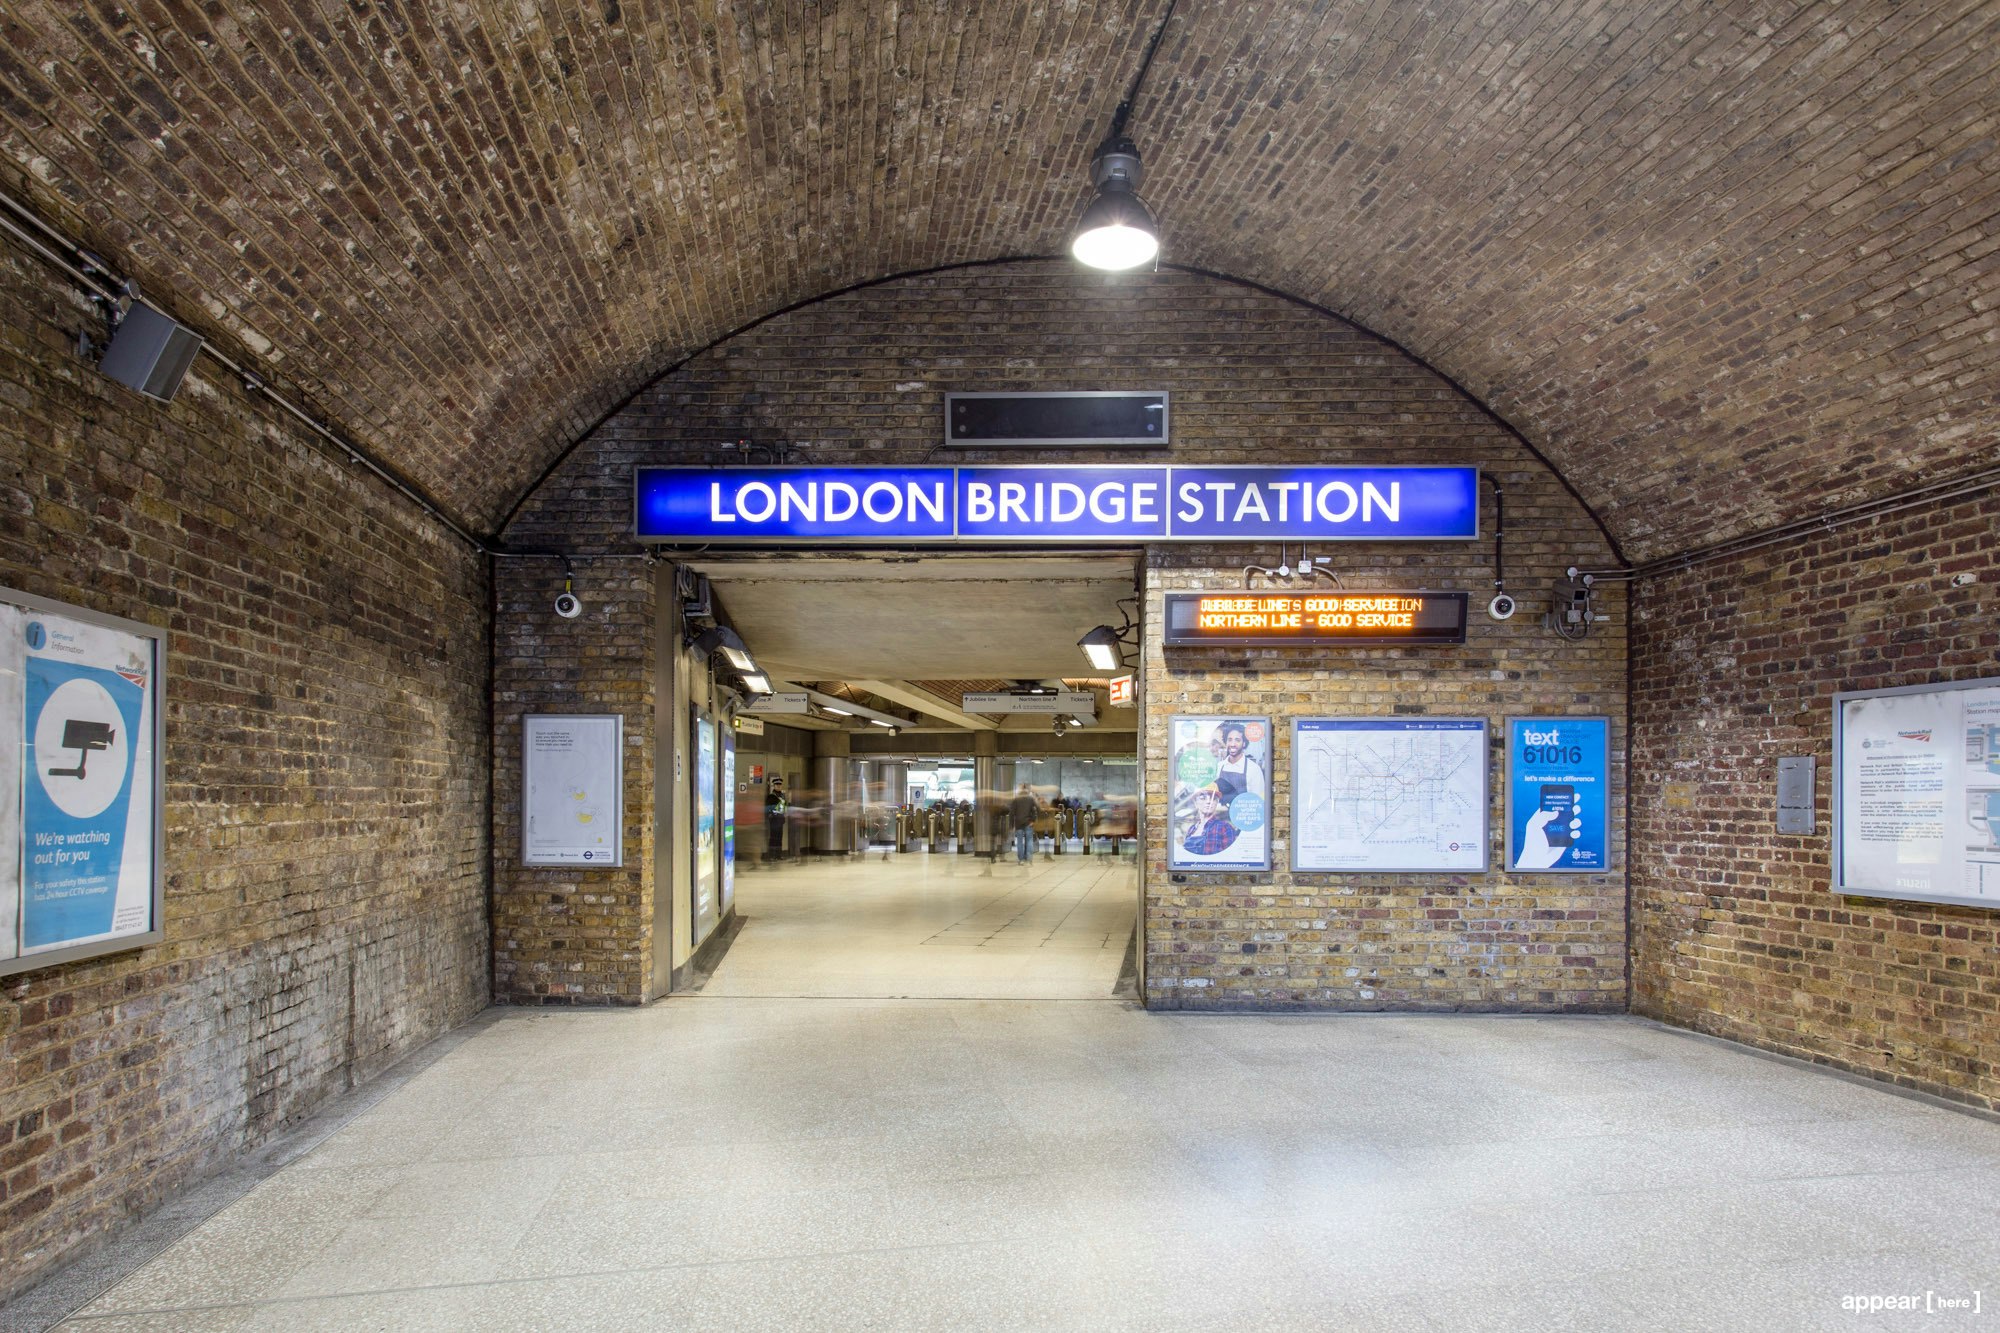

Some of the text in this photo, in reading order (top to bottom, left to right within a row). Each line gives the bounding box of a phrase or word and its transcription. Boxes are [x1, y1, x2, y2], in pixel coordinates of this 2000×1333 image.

[711, 481, 1400, 523] LONDON BRIDGE STATION
[1200, 614, 1268, 627] NORTHERN
[1271, 614, 1301, 627] LINE
[1319, 614, 1352, 627] GOOD
[1356, 614, 1412, 627] SERVICE
[51, 630, 74, 642] General
[51, 641, 85, 655] Information
[1523, 729, 1559, 746] text
[1523, 745, 1582, 765] 61016
[740, 784, 746, 792] D
[35, 830, 111, 846] We're watching
[34, 849, 90, 866] out for you
[34, 881, 44, 889] For
[45, 882, 59, 890] your
[60, 879, 77, 887] safety
[69, 888, 85, 896] CCTV
